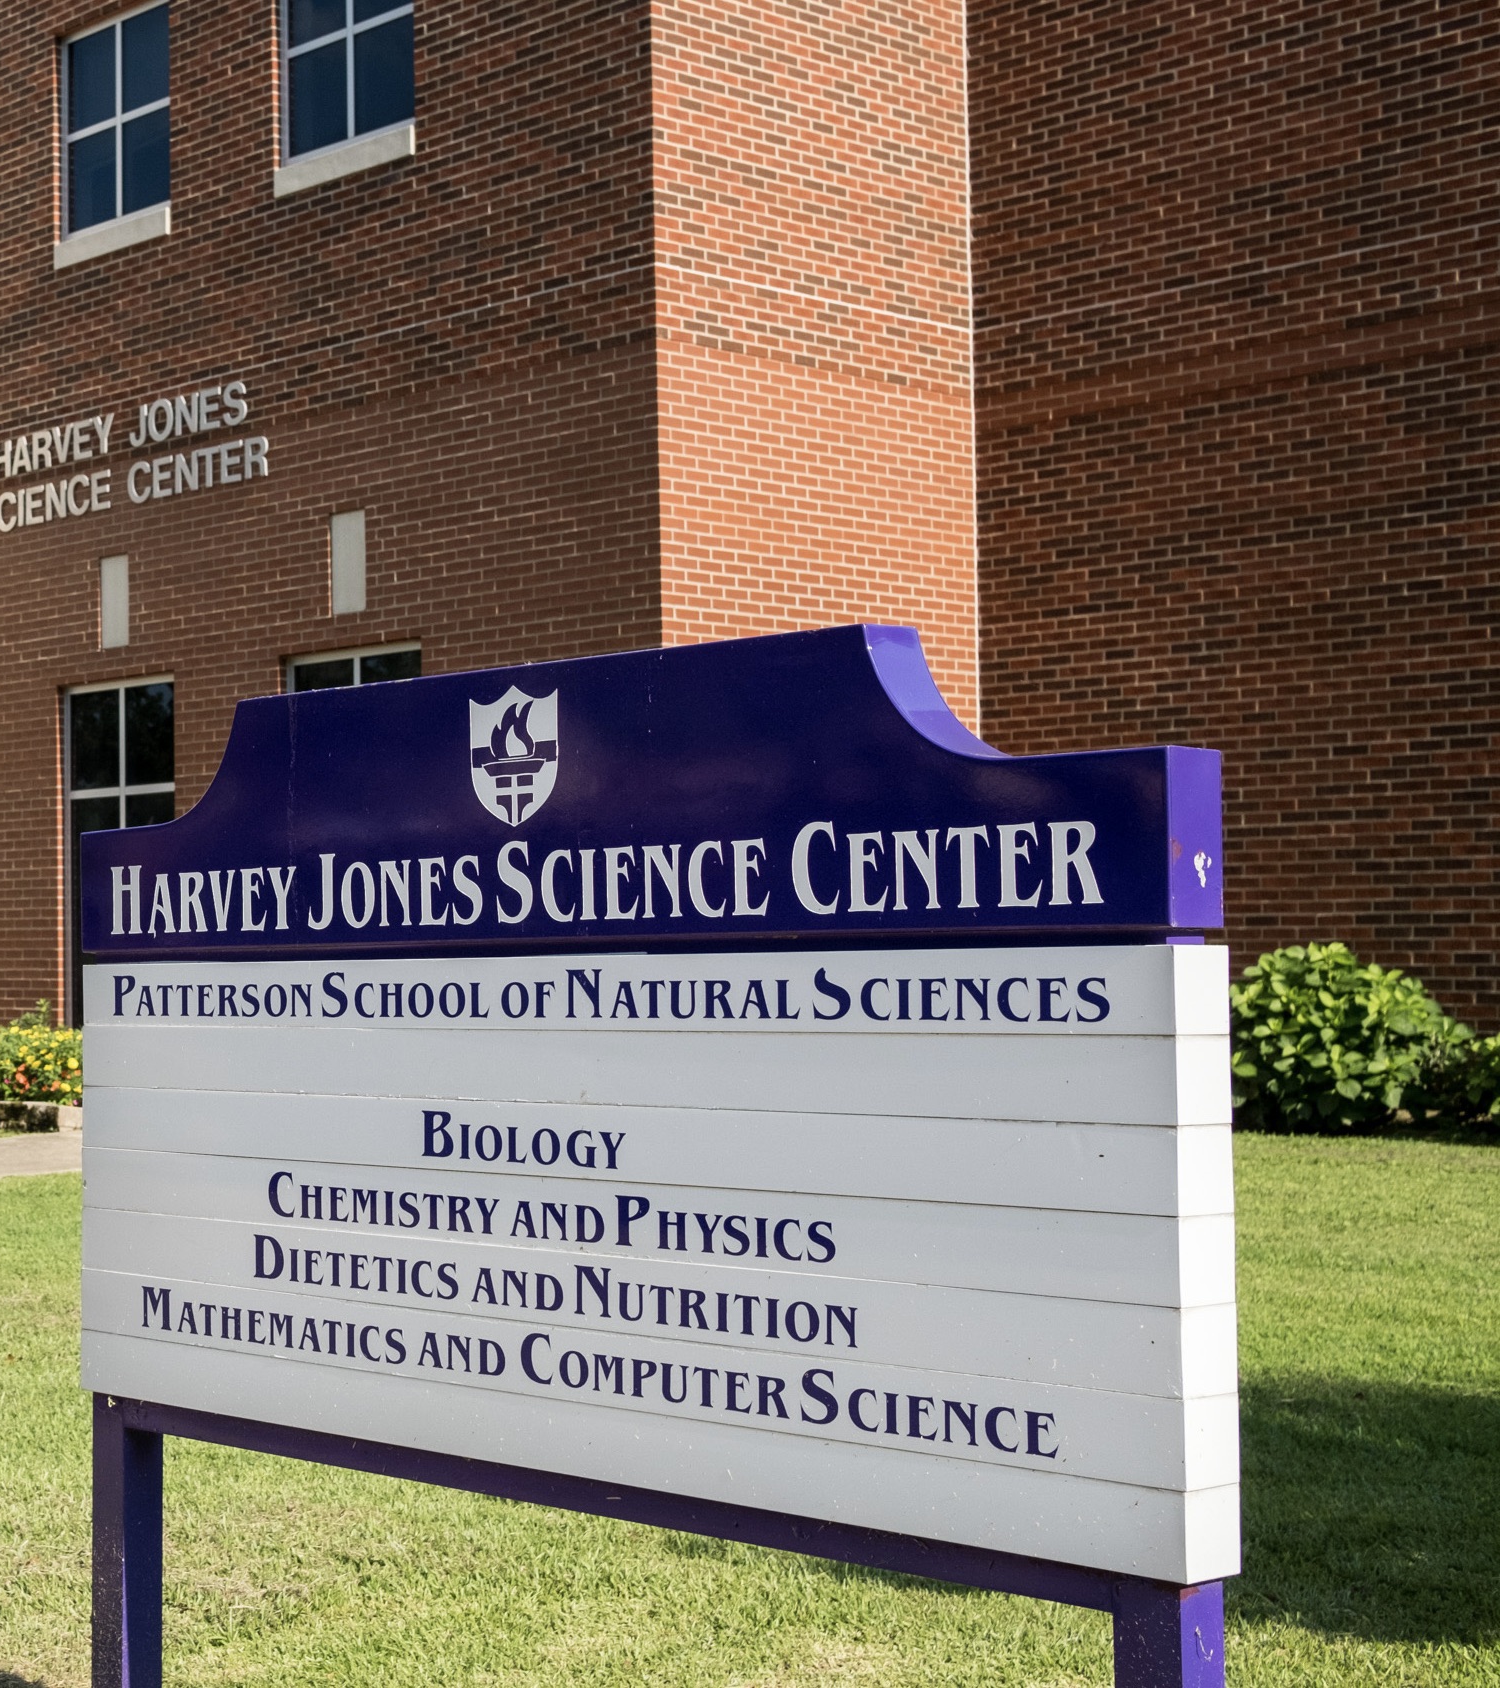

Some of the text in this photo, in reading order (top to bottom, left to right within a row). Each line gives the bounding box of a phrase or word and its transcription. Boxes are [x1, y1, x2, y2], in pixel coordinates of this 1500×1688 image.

[129, 381, 248, 447] JONES
[127, 435, 269, 504] CENTER
[109, 820, 1105, 939] HARVEY JONES SCIENCE CENTER
[112, 967, 1111, 1023] PATTERSON SCHOOL OF NATURAL SCIENCES
[421, 1110, 626, 1170] BIOLOGY
[268, 1171, 836, 1264] CHEMISTRY AND PHYSICS
[253, 1234, 859, 1349] DIETETICS AND NUTRITION
[141, 1285, 1060, 1459] MATHEMATICS AND COMPUTER SCIENCE
